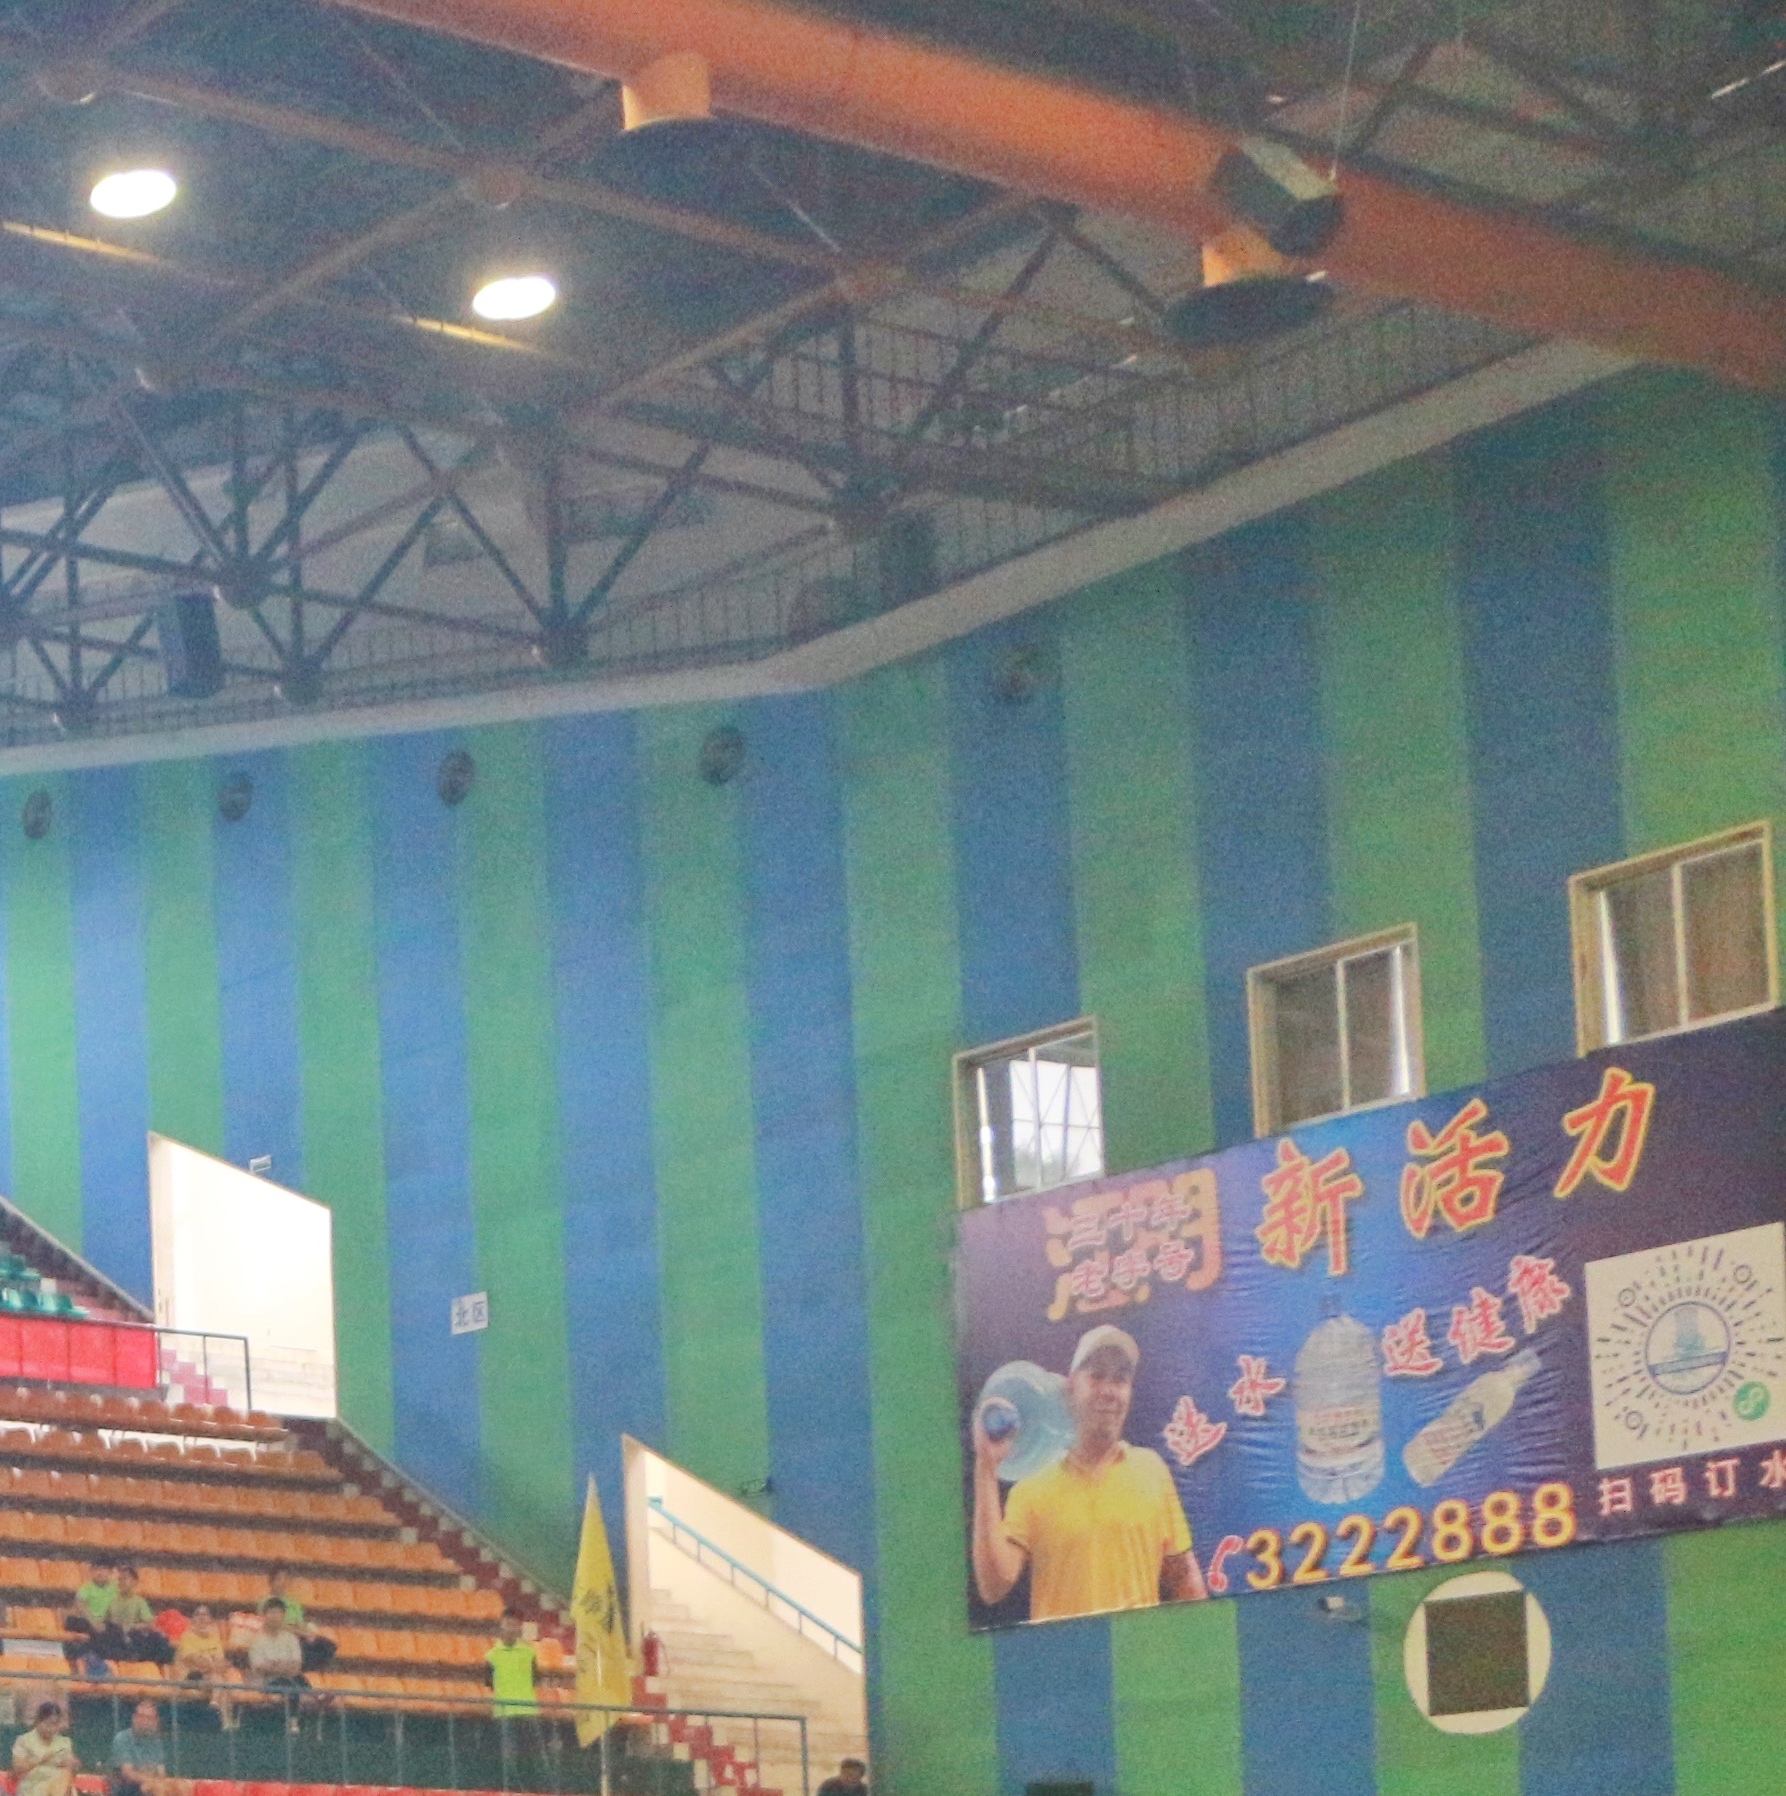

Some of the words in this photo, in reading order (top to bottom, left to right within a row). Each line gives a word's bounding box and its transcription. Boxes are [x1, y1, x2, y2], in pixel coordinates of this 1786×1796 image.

[1255, 1067, 1656, 1274] 新活力
[1067, 1191, 1191, 1251] 三十年
[1071, 1239, 1195, 1298] 老字号
[1382, 1254, 1572, 1377] 送健康
[1596, 1449, 1786, 1517] 扫码订水
[1244, 1482, 1577, 1592] 3222888
